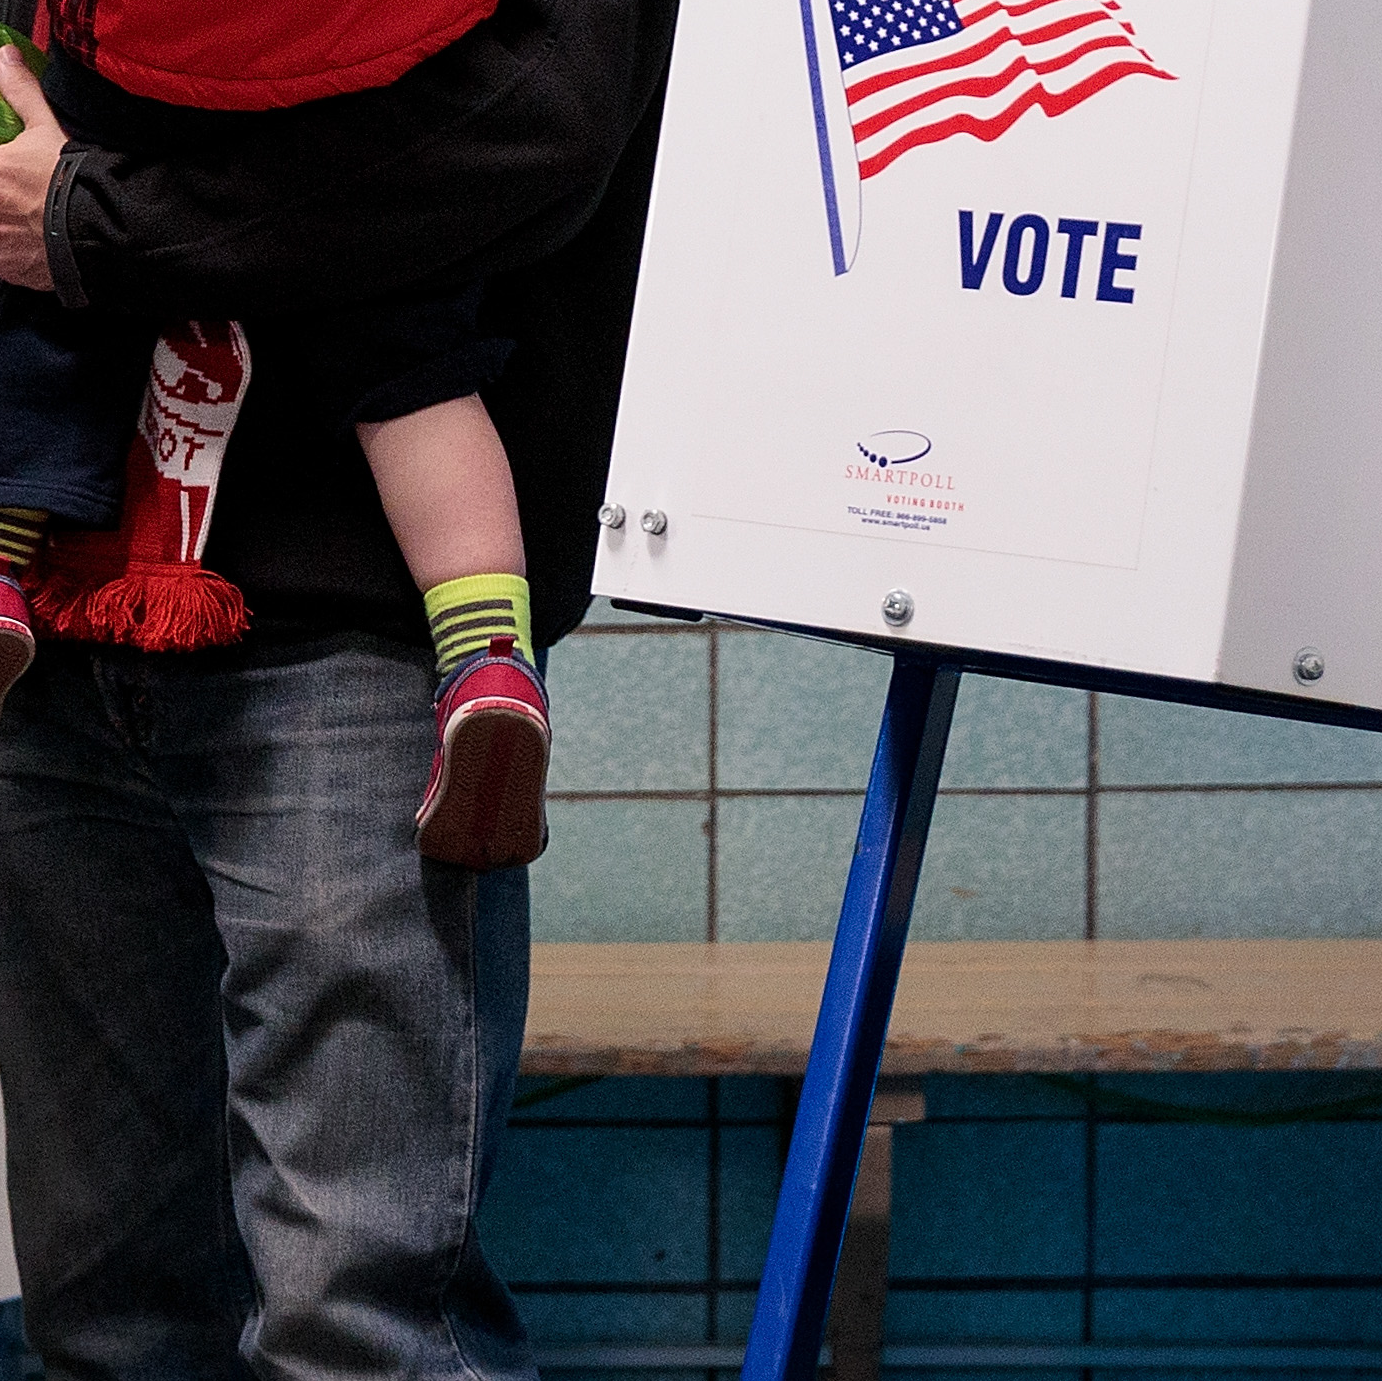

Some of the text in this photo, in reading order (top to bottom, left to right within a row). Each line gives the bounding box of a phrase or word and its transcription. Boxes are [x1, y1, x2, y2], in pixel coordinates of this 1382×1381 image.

[958, 209, 1142, 304] VOTE
[845, 464, 955, 490] SMARTPOLL
[847, 506, 867, 516] TOLL
[886, 495, 965, 511] VOTING BOOTH
